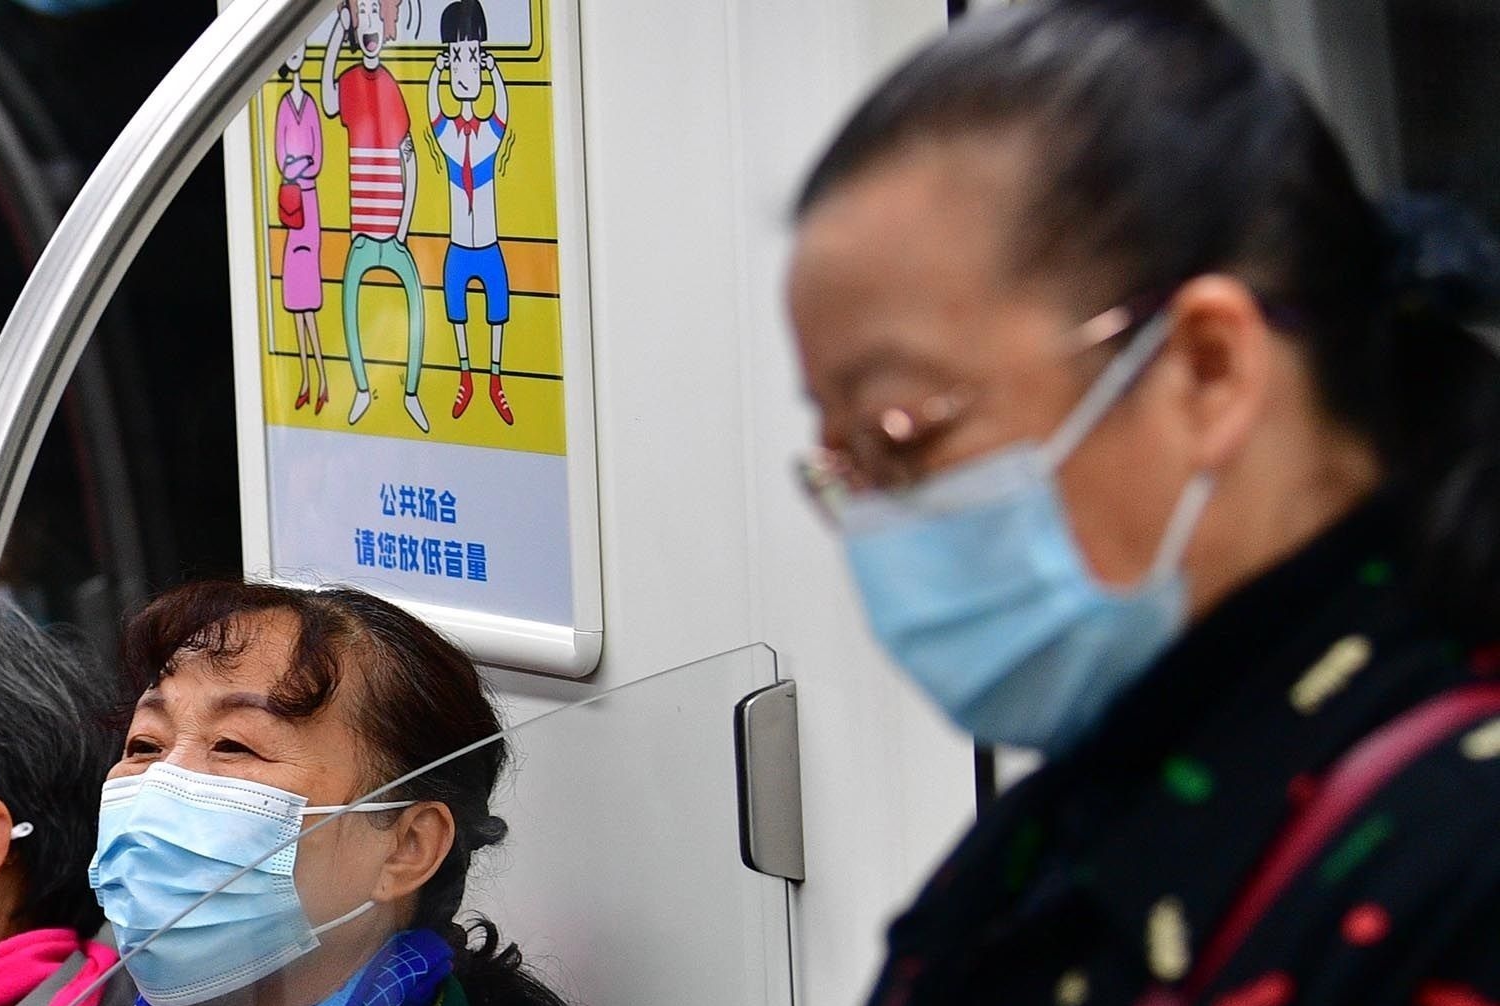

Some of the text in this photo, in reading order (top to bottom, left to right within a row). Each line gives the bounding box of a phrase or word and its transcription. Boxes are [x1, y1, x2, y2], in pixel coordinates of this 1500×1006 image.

[380, 483, 457, 524] 公共场合
[354, 528, 487, 582] 请您放低音量
